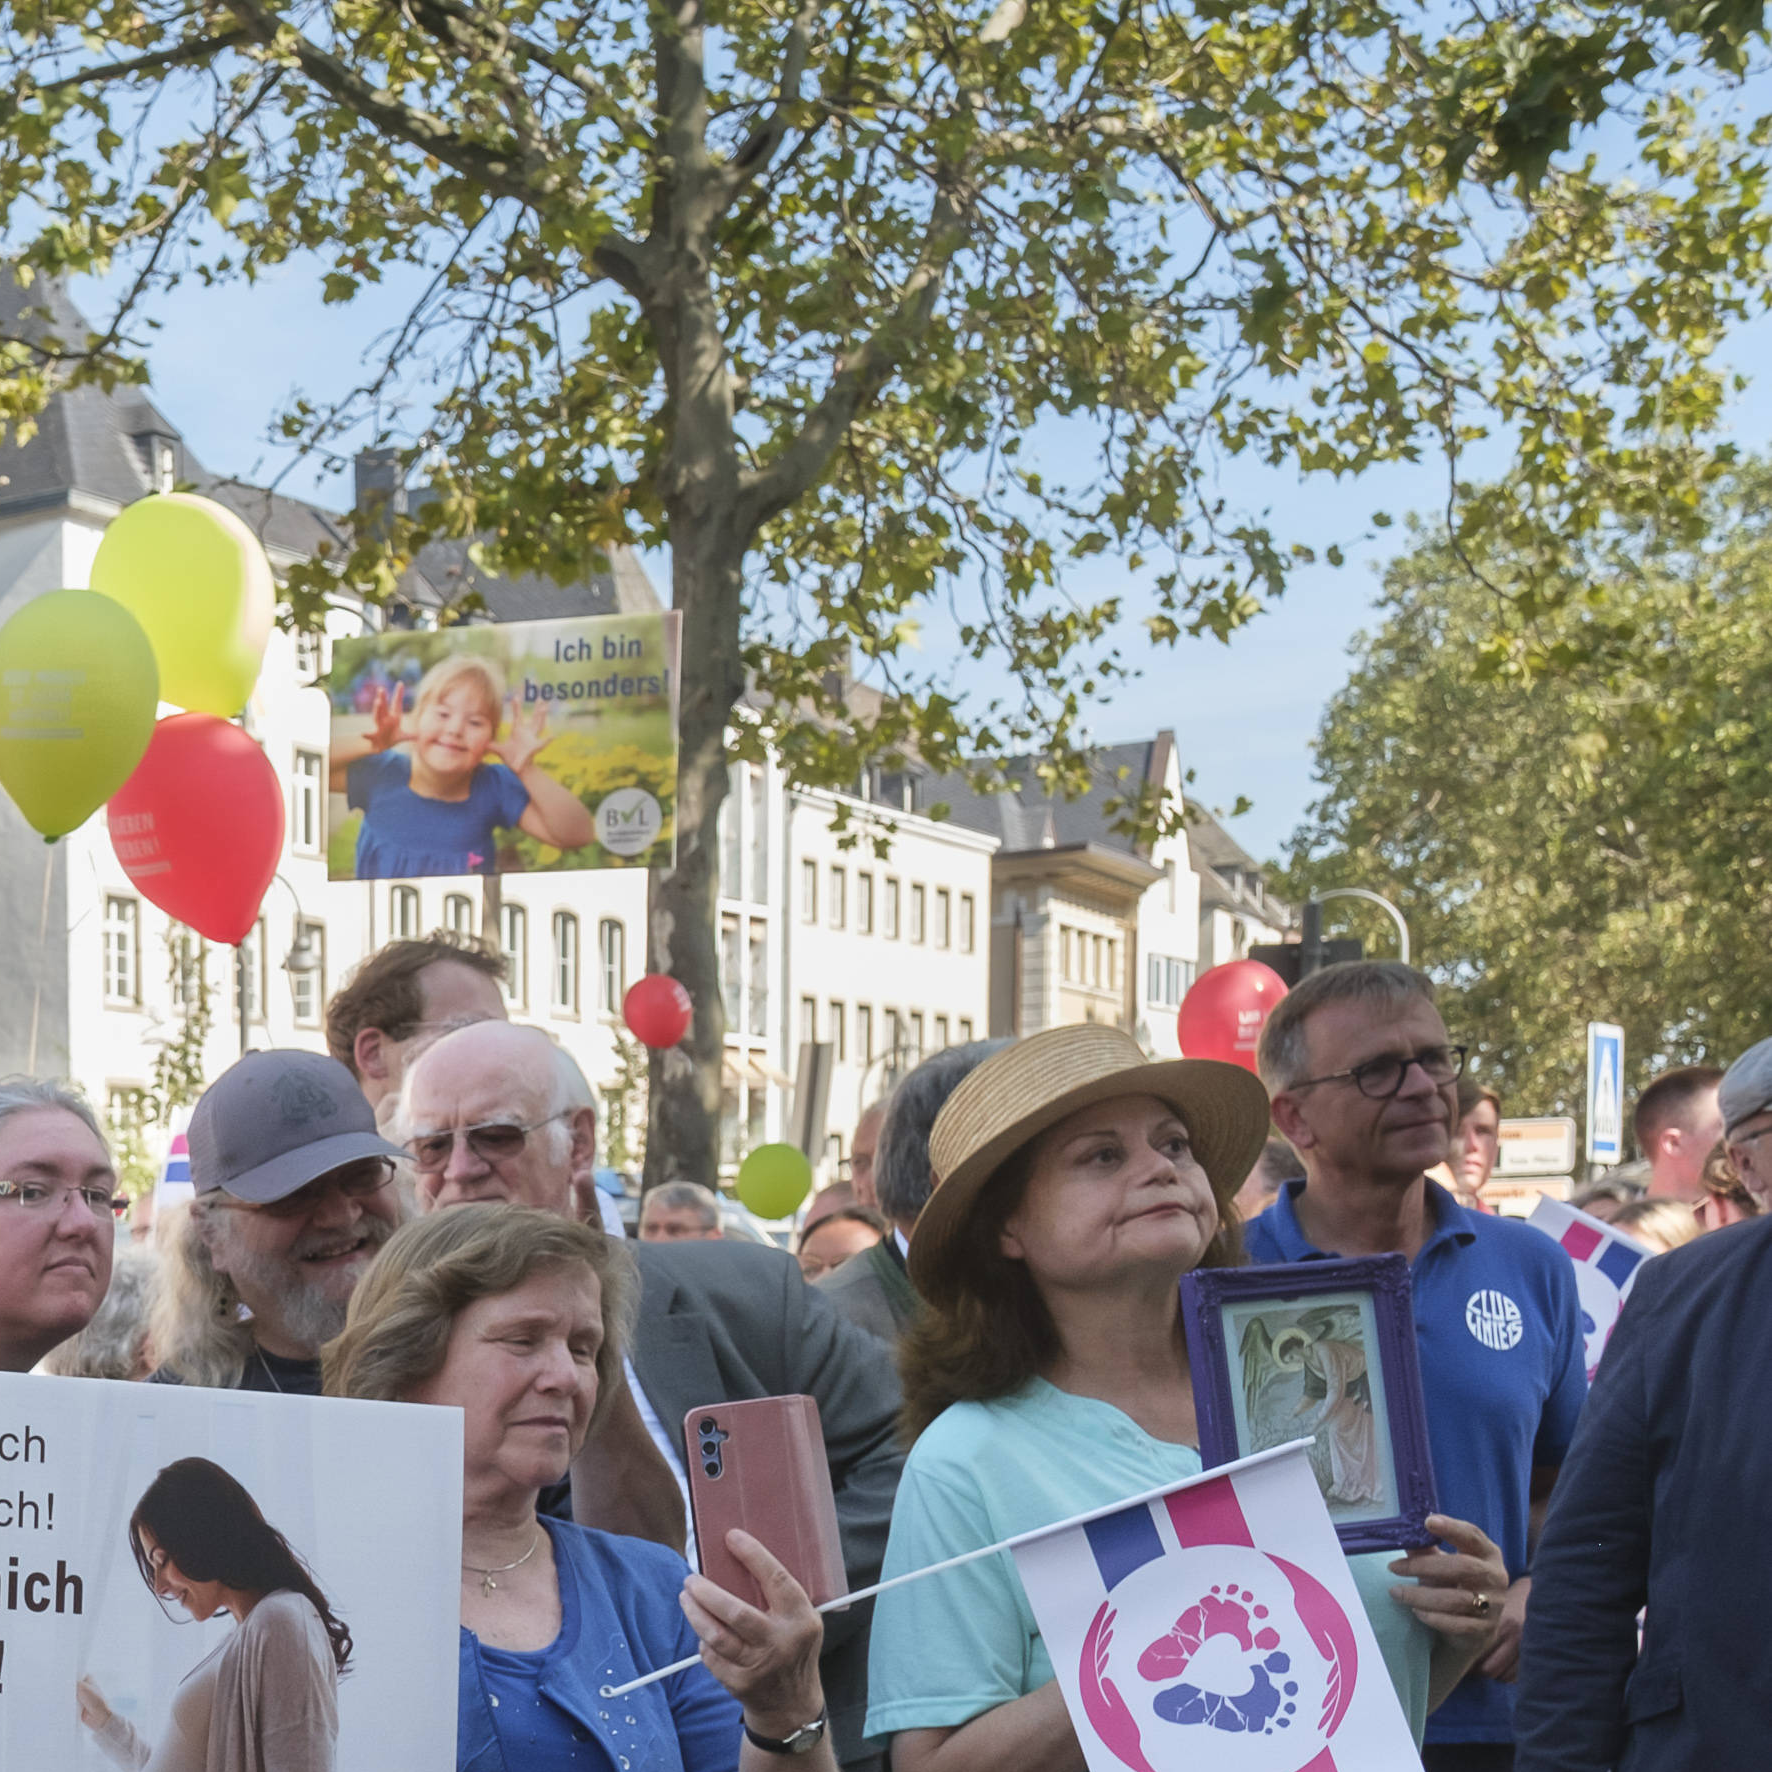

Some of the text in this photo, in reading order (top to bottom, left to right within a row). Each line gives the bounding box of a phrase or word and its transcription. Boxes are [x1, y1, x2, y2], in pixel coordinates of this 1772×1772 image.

[554, 633, 642, 663] Ich bin
[525, 669, 670, 702] besonders!
[1467, 1290, 1521, 1321] CLUB
